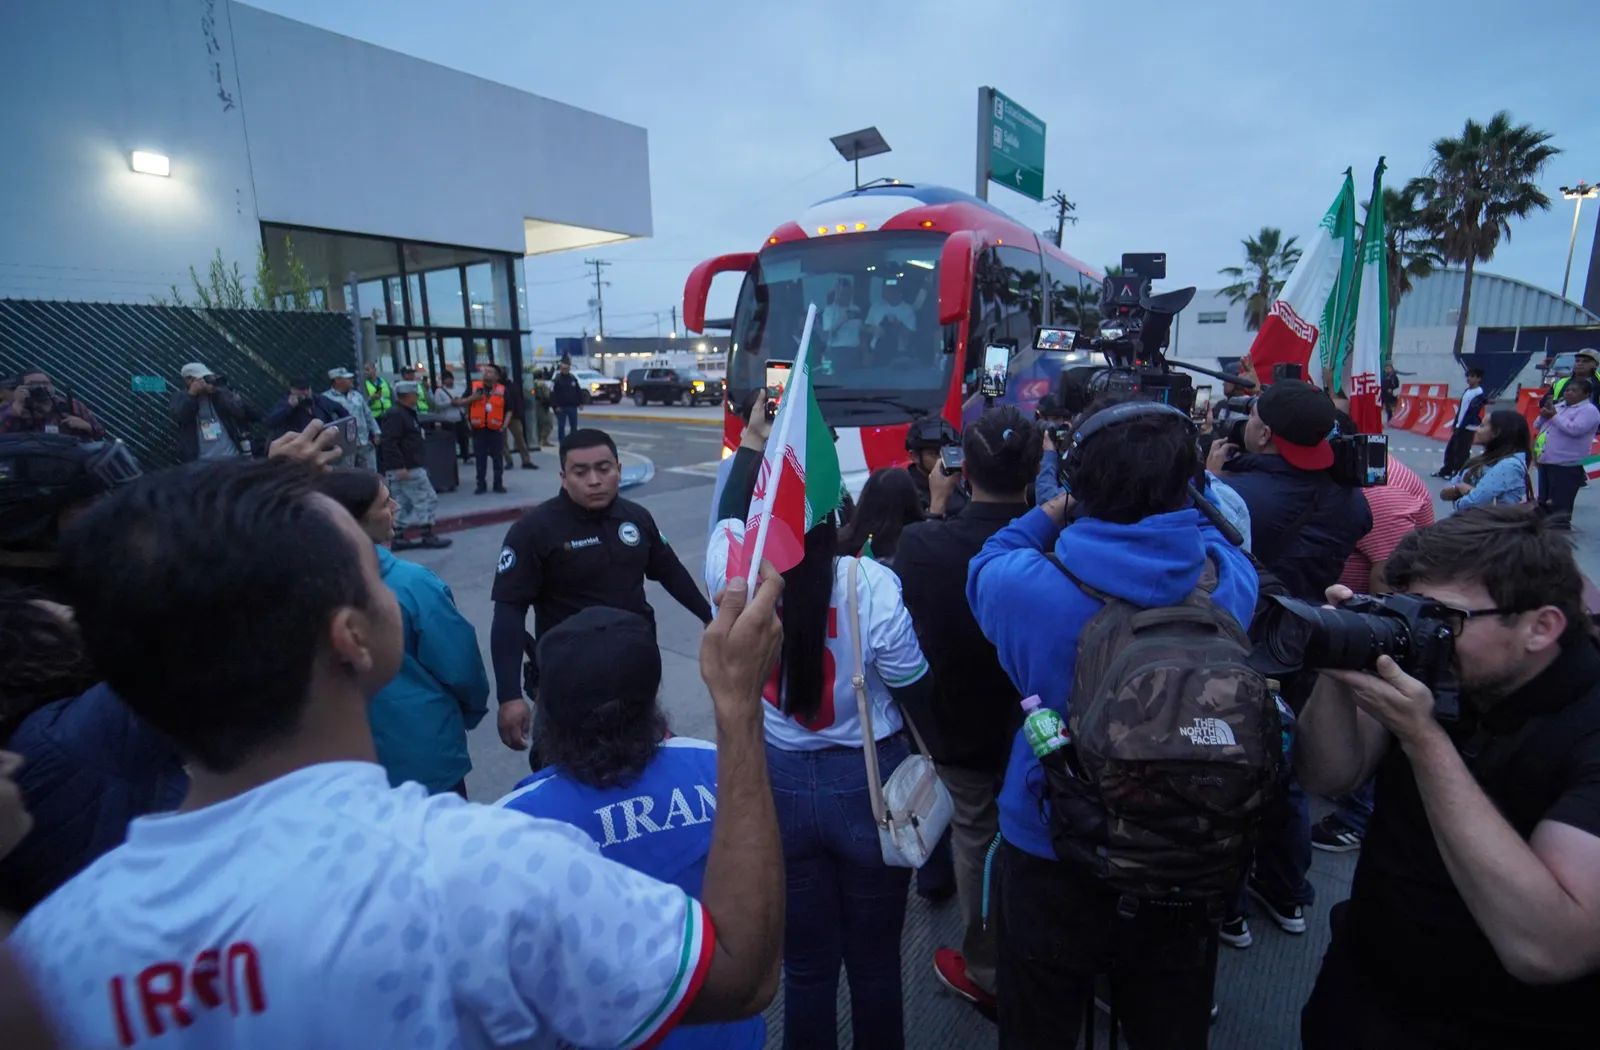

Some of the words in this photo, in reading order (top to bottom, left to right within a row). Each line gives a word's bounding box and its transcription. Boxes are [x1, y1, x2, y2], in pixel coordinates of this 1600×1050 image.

[1193, 717, 1215, 727] THE
[1179, 726, 1215, 736] NORTH
[1191, 735, 1217, 745] FACE
